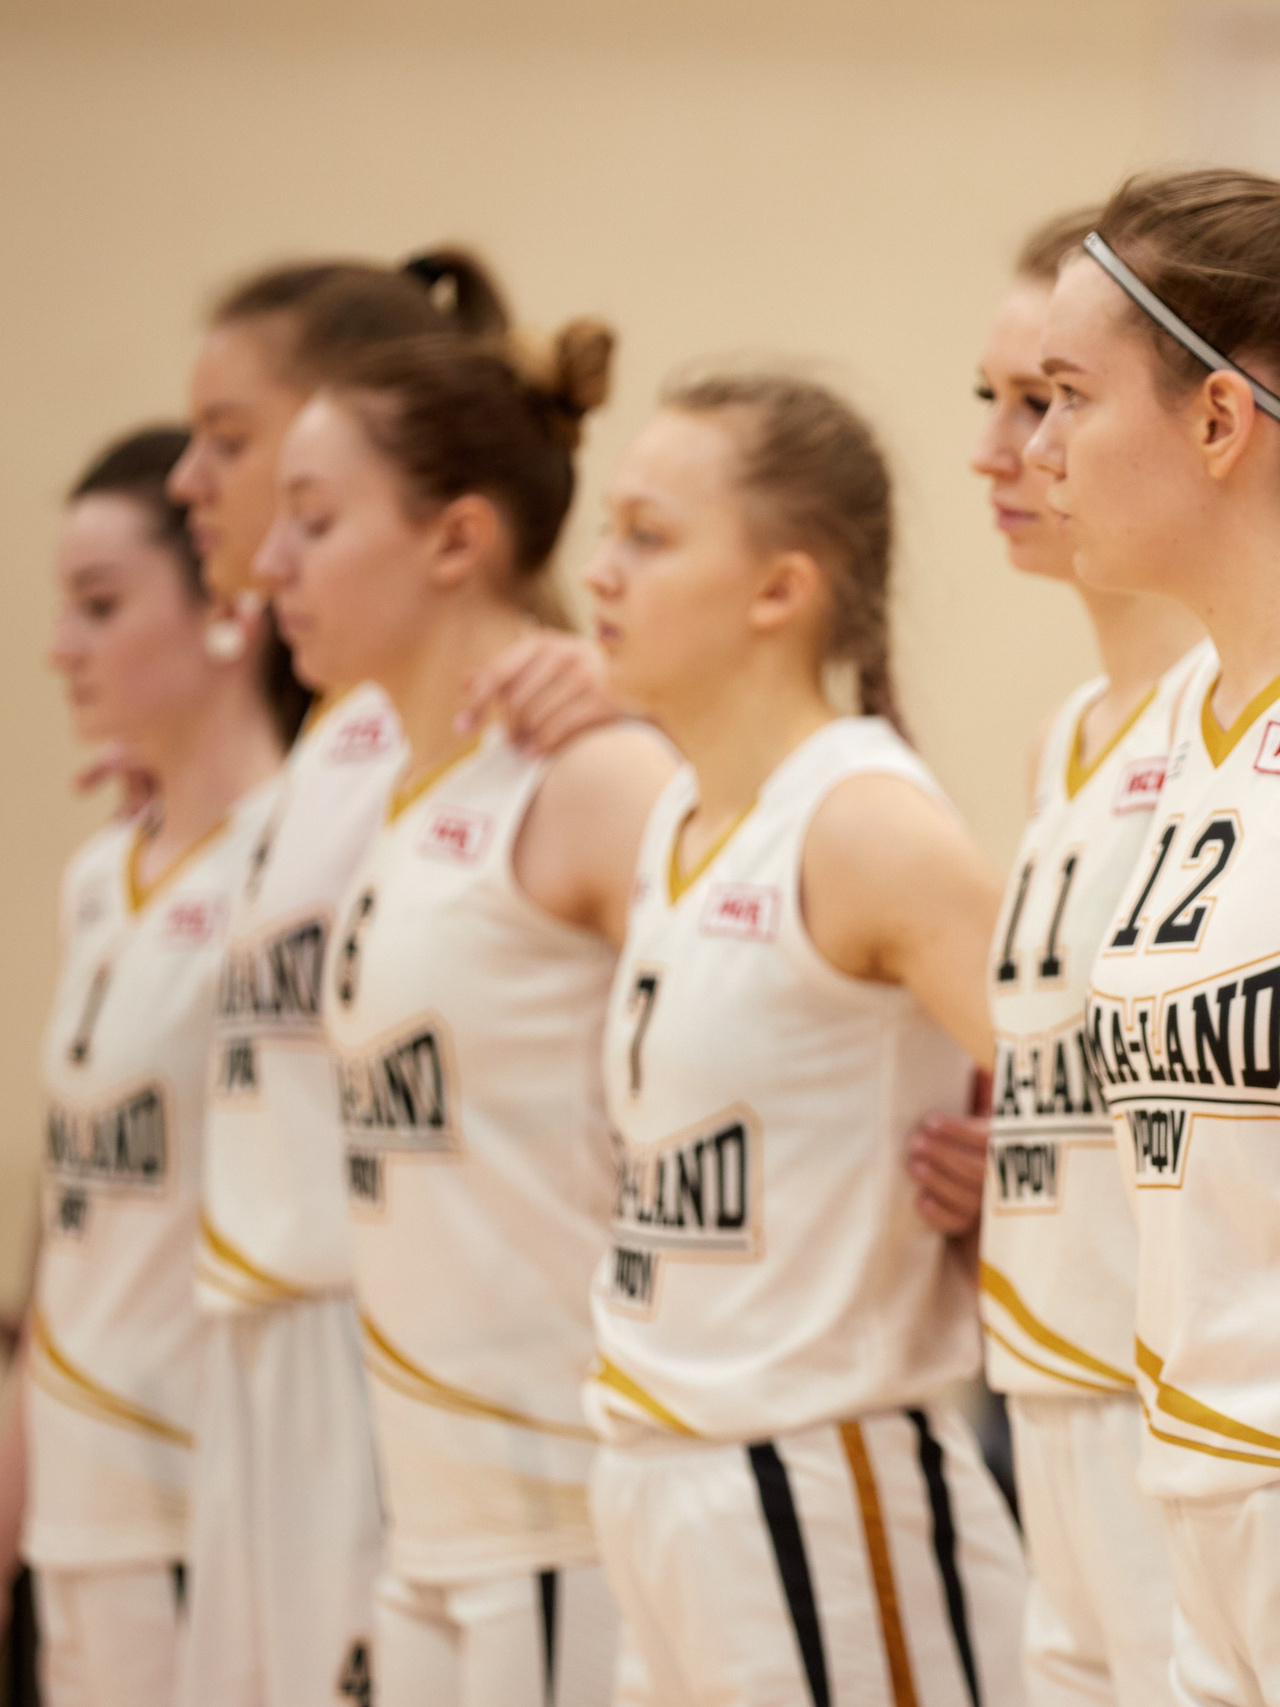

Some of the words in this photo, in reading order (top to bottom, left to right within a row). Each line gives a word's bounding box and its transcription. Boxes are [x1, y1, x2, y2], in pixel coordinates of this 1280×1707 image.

[996, 854, 1080, 983] 11
[1109, 818, 1238, 949] 12
[629, 972, 659, 1098] 7
